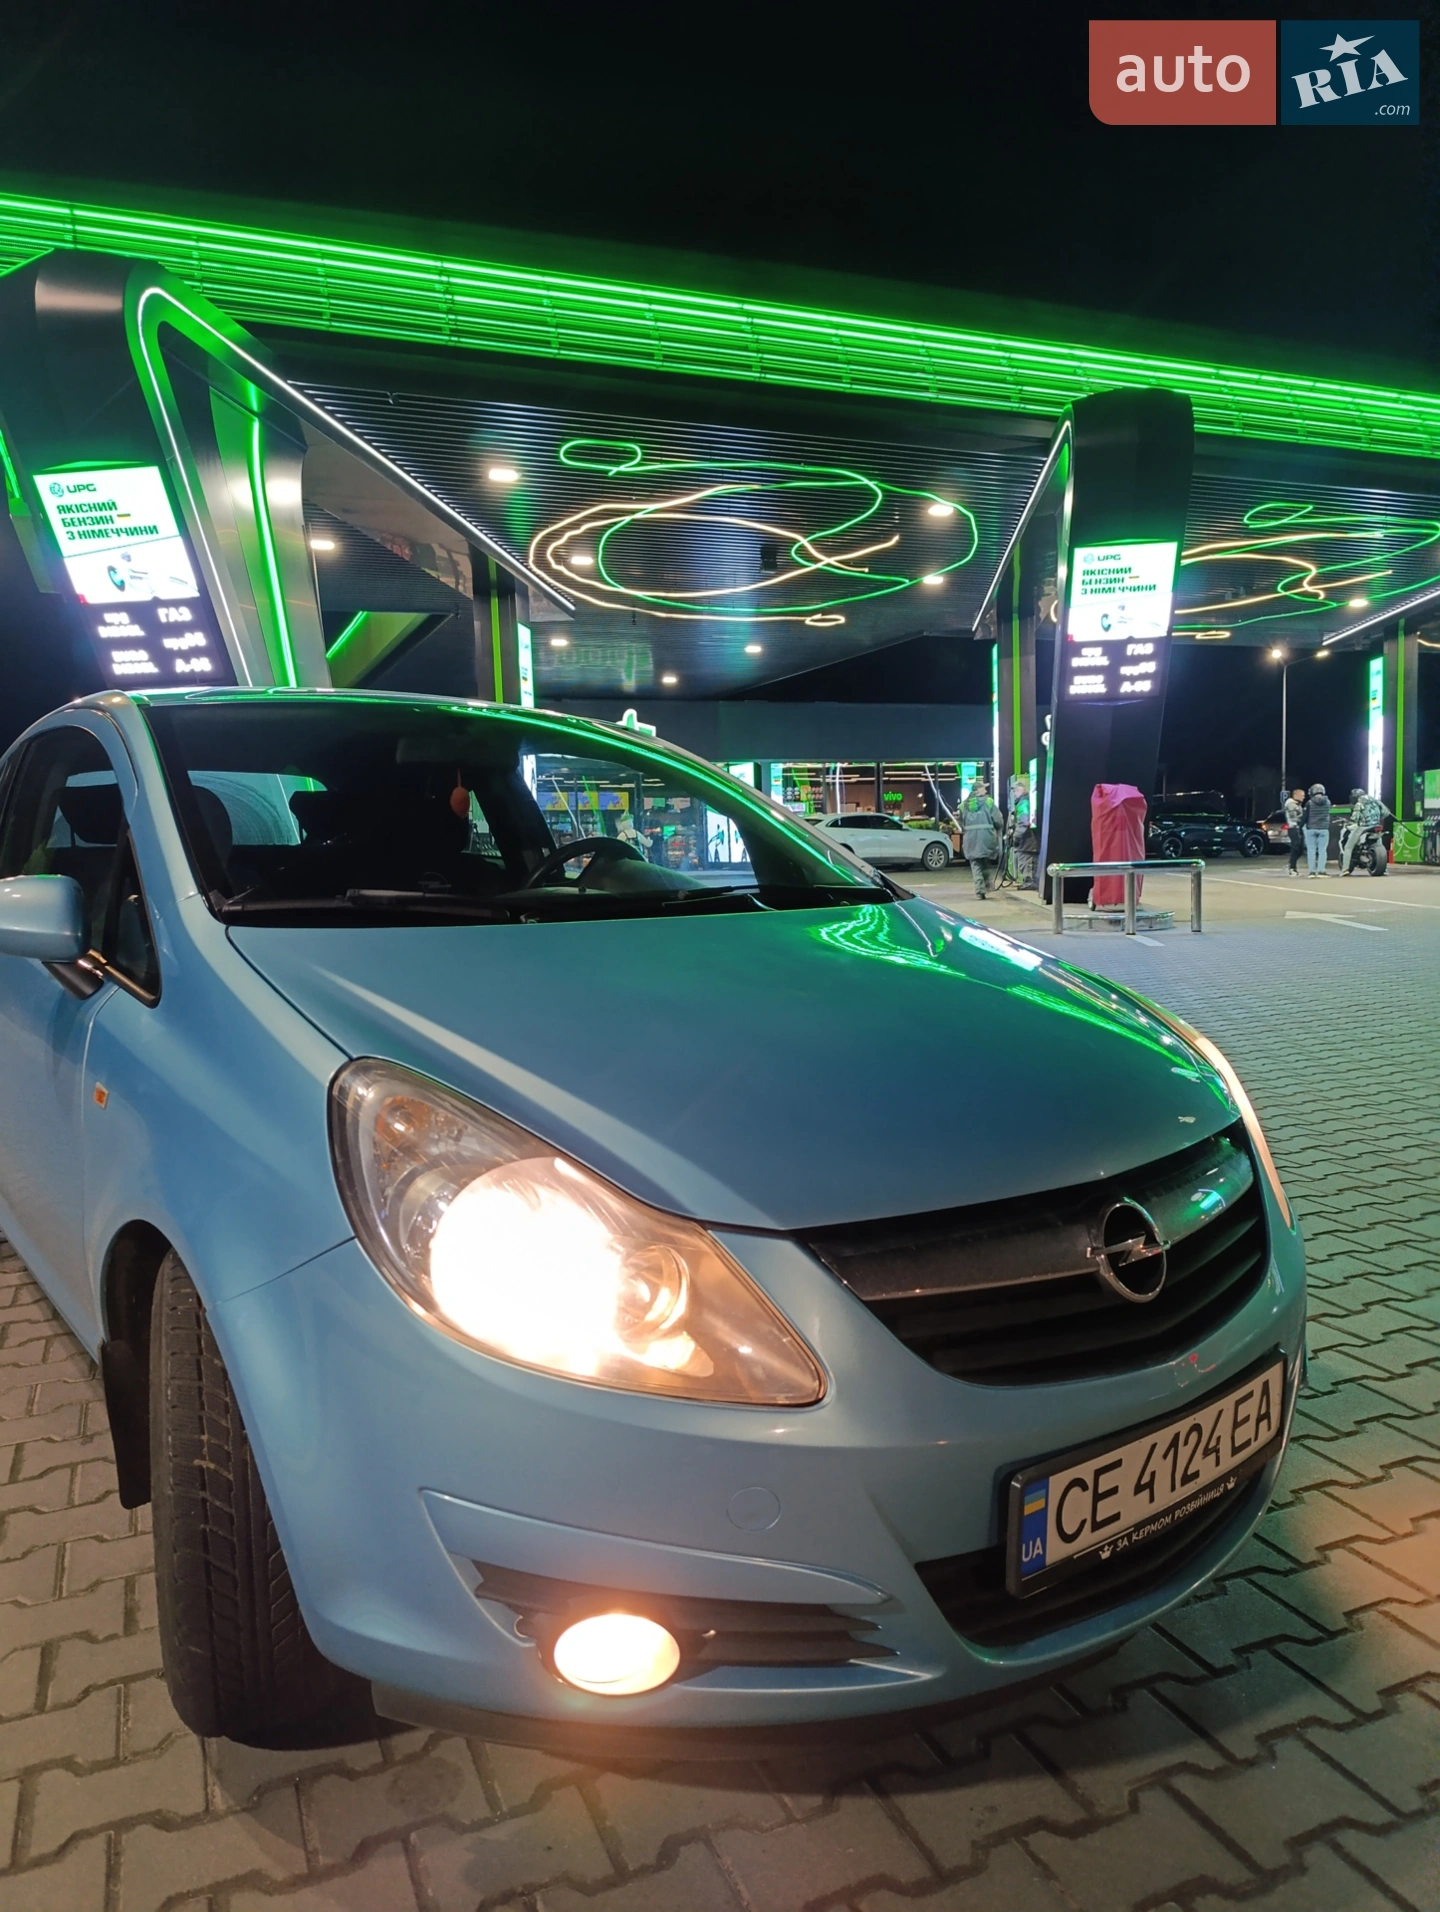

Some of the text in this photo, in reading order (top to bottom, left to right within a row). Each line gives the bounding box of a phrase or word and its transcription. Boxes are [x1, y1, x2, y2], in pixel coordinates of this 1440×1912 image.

[66, 483, 97, 494] UPG
[56, 499, 118, 515] ЯКІСНИЙ
[61, 515, 115, 528] БЕНЗИН
[78, 525, 159, 540] НІМЕЧЧИНИ
[1097, 554, 1121, 562] UPG
[883, 791, 903, 801] vivo
[1056, 1379, 1272, 1544] CE 4124 EA
[1116, 1484, 1225, 1551] ЗА КЕРМОМ РОЗБІЙНИЦЯ
[1022, 1537, 1043, 1562] UA
